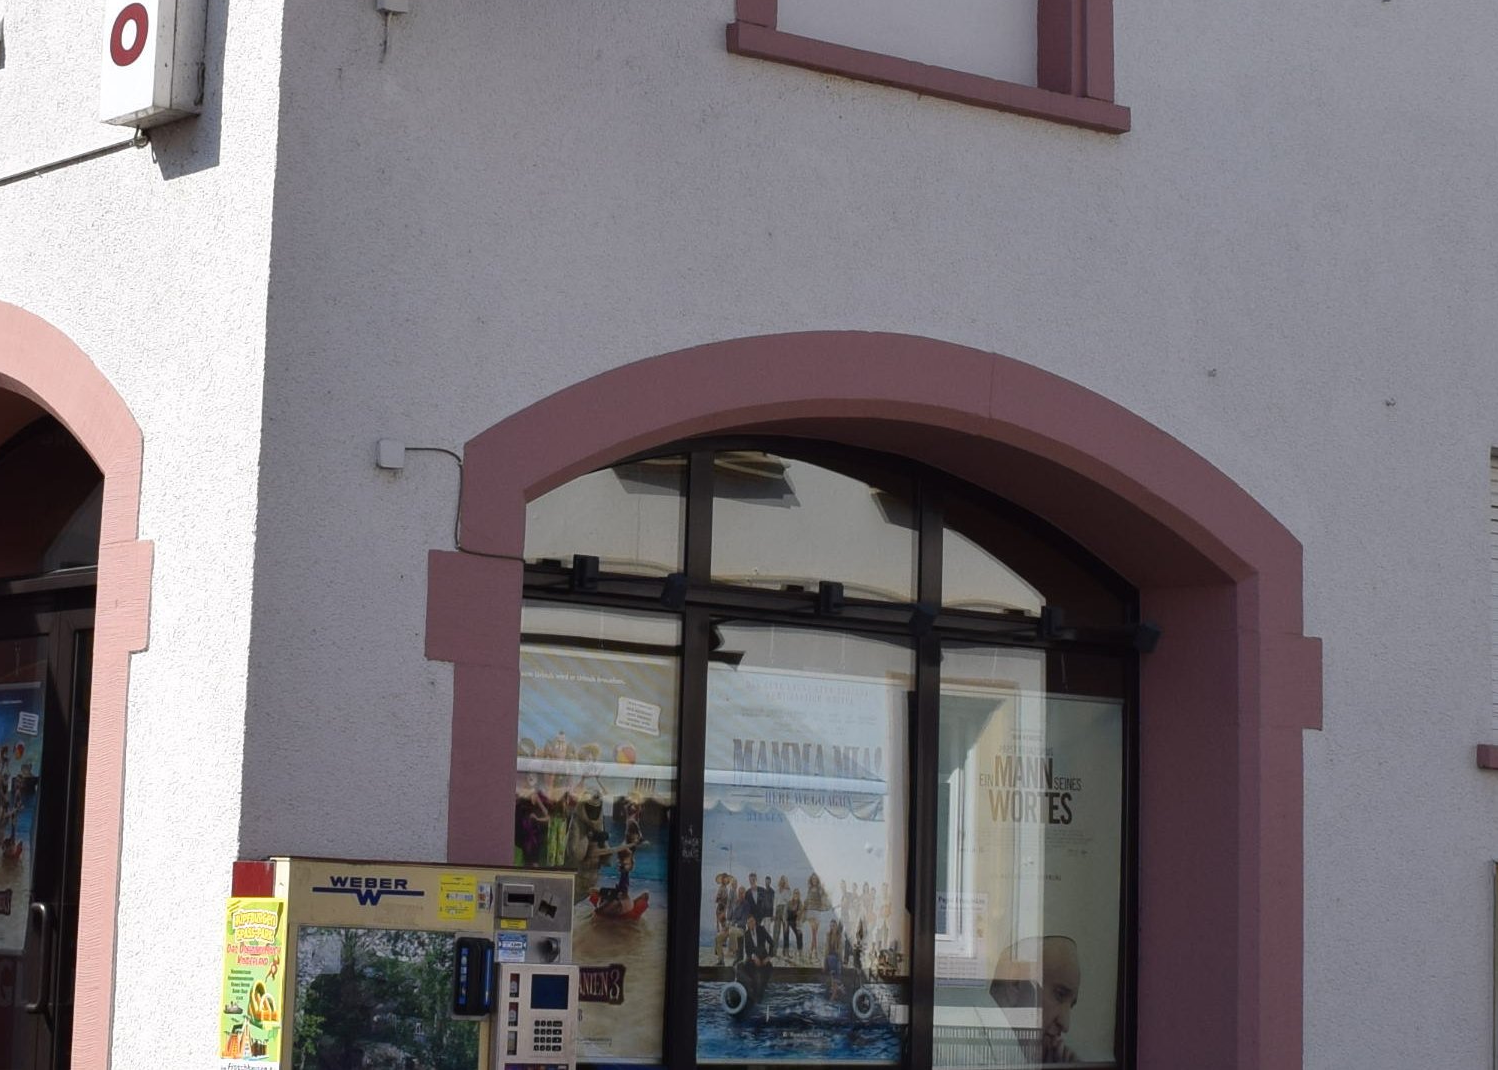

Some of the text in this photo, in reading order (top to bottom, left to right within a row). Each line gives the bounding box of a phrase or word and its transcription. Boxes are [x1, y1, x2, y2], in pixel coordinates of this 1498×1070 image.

[733, 739, 825, 786] MAMMA
[979, 755, 1082, 791] EIN MANN SEINES
[988, 789, 1073, 825] WORTES
[329, 876, 408, 890] WEBER
